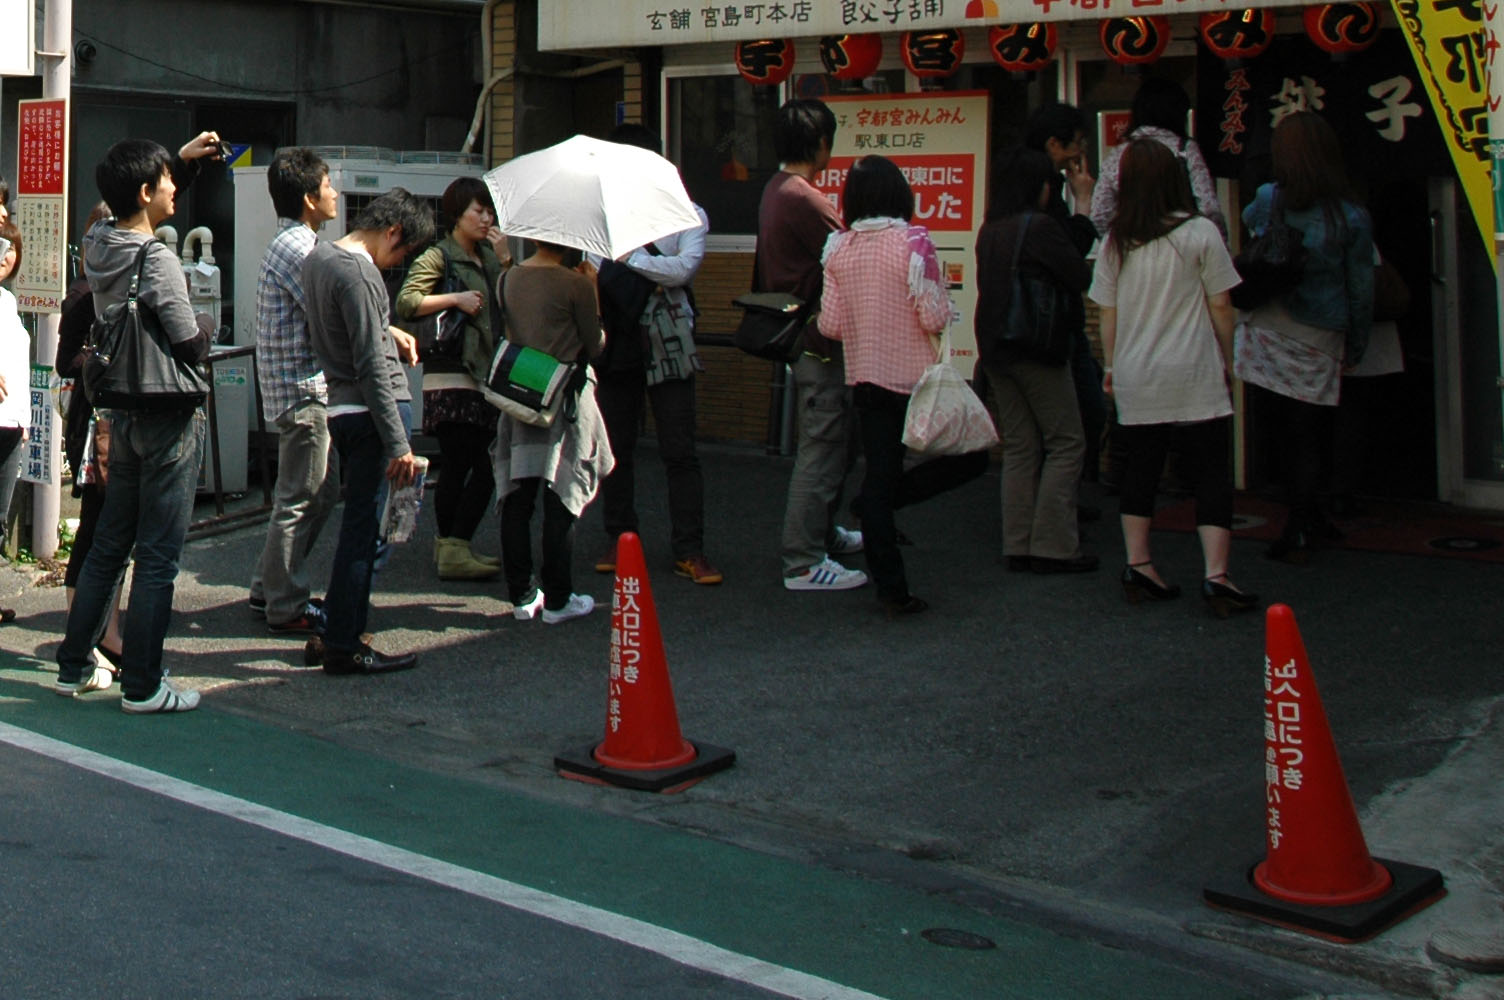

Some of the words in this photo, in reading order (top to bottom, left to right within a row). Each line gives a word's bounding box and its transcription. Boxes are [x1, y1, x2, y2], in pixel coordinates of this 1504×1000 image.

[701, 0, 813, 29] 宮島町本店
[856, 107, 966, 128] 宇都宮みんみん
[855, 132, 926, 149] 駅東口店
[622, 576, 640, 684] 出入口につき
